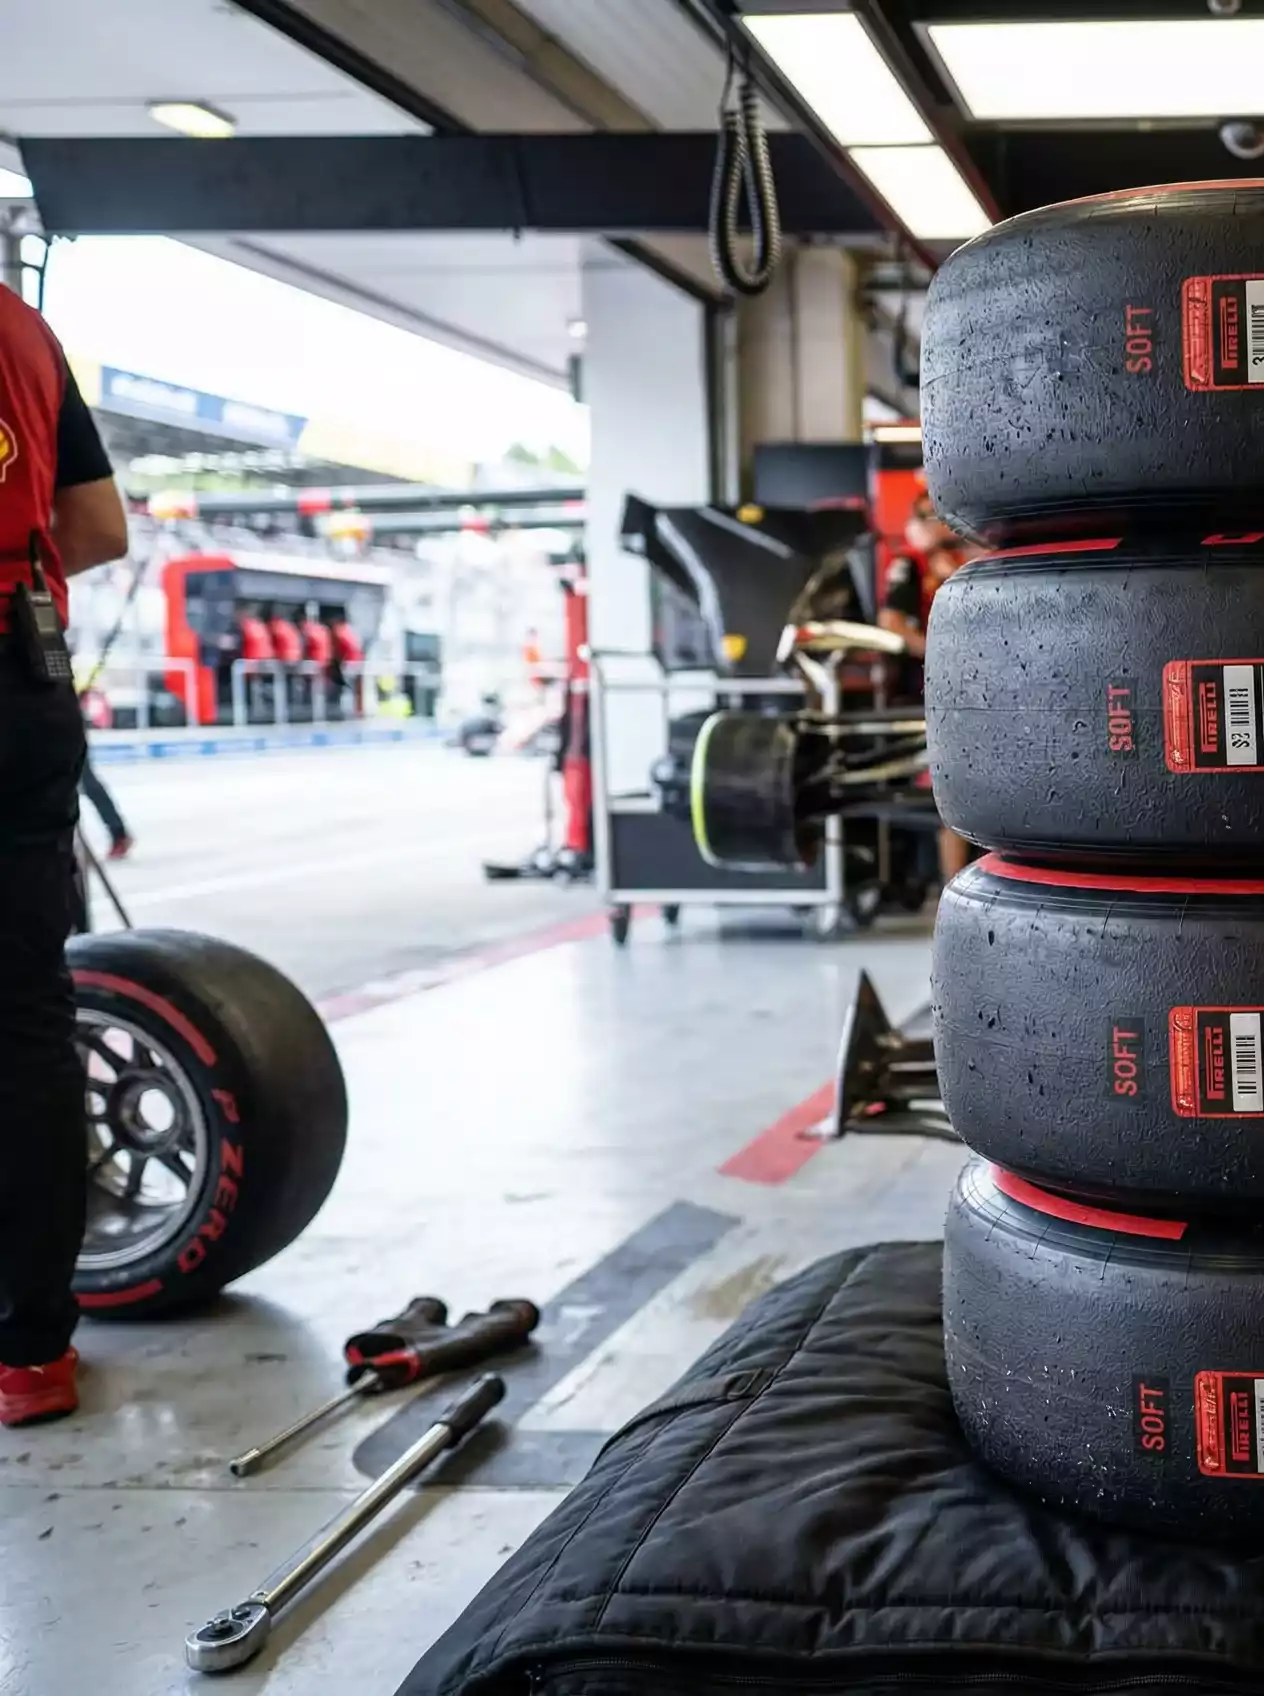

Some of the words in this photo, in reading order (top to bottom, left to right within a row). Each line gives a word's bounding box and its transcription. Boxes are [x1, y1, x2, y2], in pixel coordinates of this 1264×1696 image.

[1125, 303, 1154, 374] SOFT
[1219, 296, 1239, 369] PIRELLI
[1108, 683, 1134, 752] SOFT
[1198, 682, 1218, 753] PIRELLI
[1113, 1026, 1140, 1097] SOFT
[1205, 1026, 1225, 1100] PIRELLI
[177, 1136, 244, 1274] ZERO
[1139, 1383, 1166, 1451] SOFT
[1229, 1391, 1251, 1461] PIRELLI
